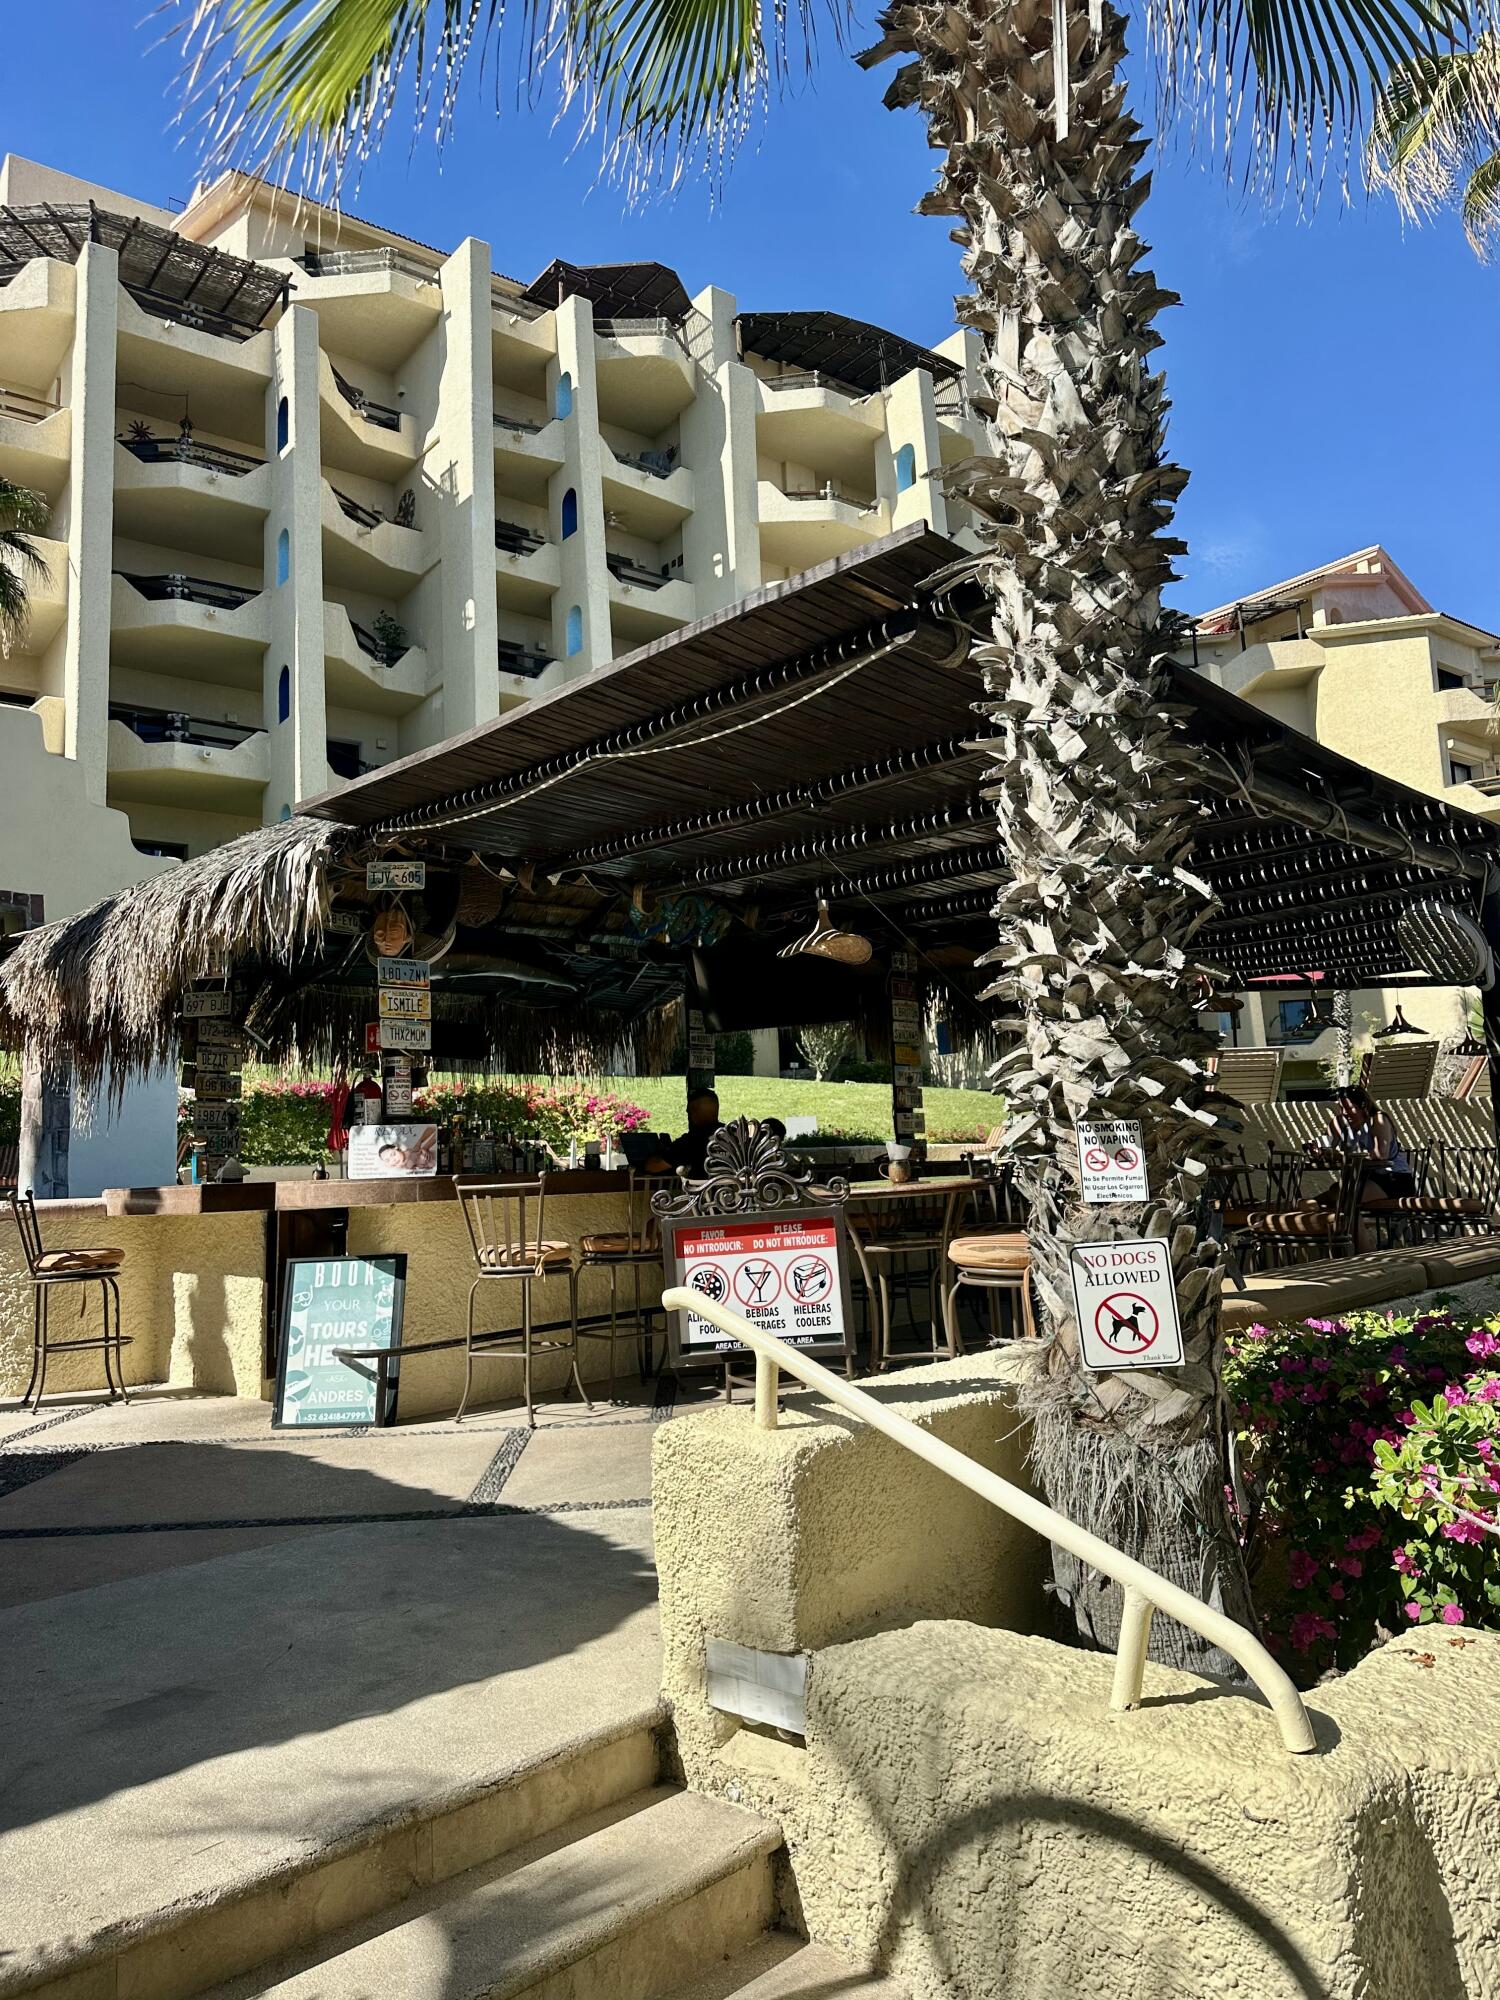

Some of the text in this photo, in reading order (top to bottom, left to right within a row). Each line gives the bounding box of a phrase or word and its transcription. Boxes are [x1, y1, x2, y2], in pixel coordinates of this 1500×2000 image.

[186, 999, 229, 1012] 697 BJH
[387, 997, 423, 1013] ISMILE
[389, 1026, 427, 1041] THX2MOM
[1078, 1122, 1139, 1133] NO SMOKING
[1084, 1134, 1136, 1145] NO VAPING
[700, 1229, 725, 1241] FAVOR
[774, 1223, 806, 1235] PLEASE,
[683, 1240, 744, 1255] NO INTRODUCIR:
[752, 1233, 828, 1249] DO NOT INTRODUCE:
[1083, 1250, 1157, 1269] NO DOGS
[314, 1261, 376, 1288] BOOK
[1085, 1269, 1160, 1287] ALLOWED
[323, 1299, 360, 1312] YOUR
[745, 1303, 832, 1319] BEBIDAS HIELERAS
[796, 1316, 831, 1328] COOLERS
[310, 1320, 368, 1340] TOURS
[699, 1324, 721, 1335] FOOD
[715, 1342, 732, 1350] AREA
[782, 1337, 796, 1345] OOL
[796, 1336, 815, 1344] AREA
[306, 1390, 364, 1404] ANDRES
